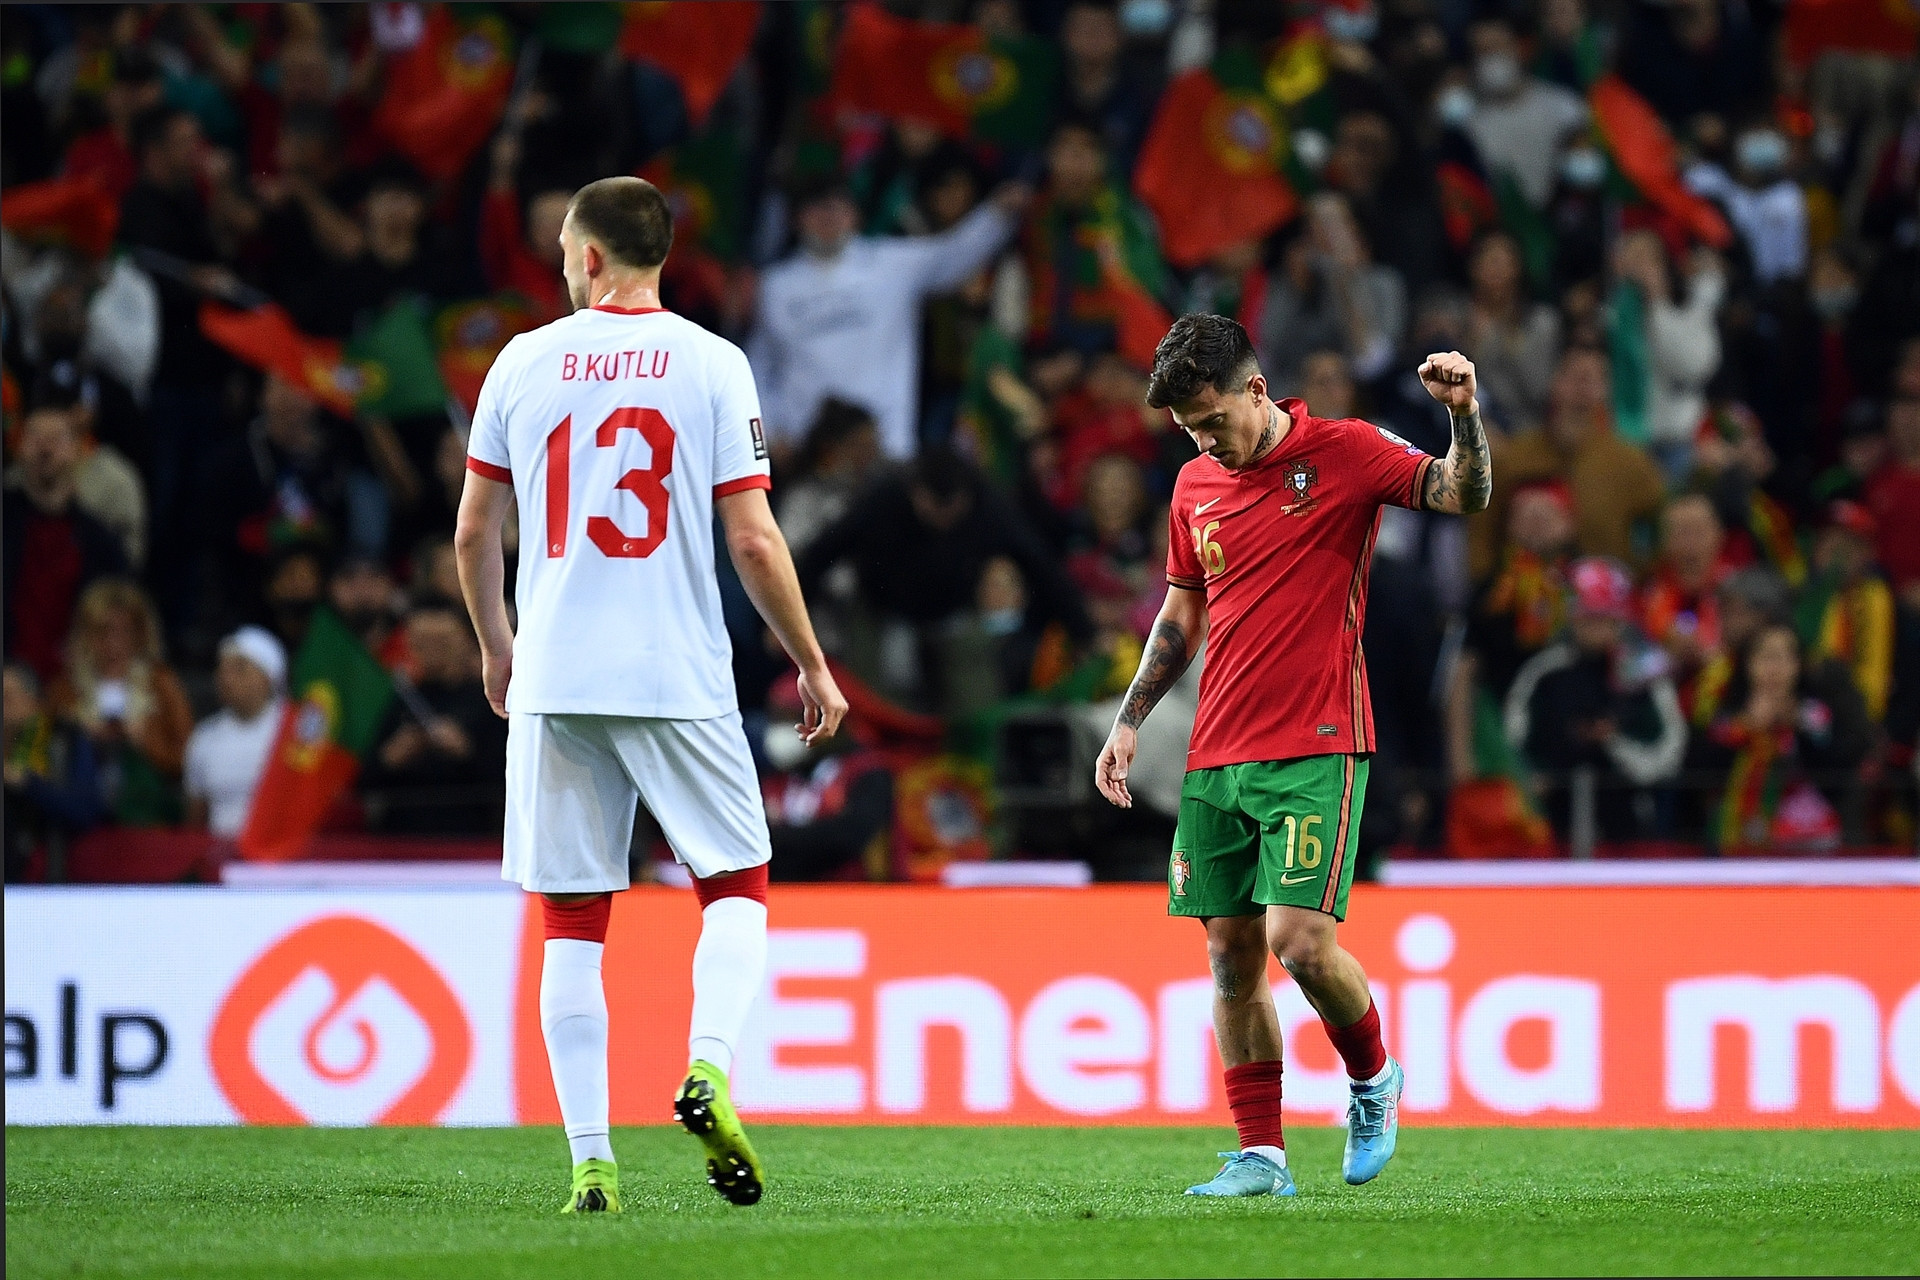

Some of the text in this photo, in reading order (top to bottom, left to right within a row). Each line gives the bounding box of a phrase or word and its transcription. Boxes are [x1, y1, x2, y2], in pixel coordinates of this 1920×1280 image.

[561, 350, 669, 381] B.KUTLU
[546, 406, 676, 559] 13
[1284, 815, 1323, 869] 16
